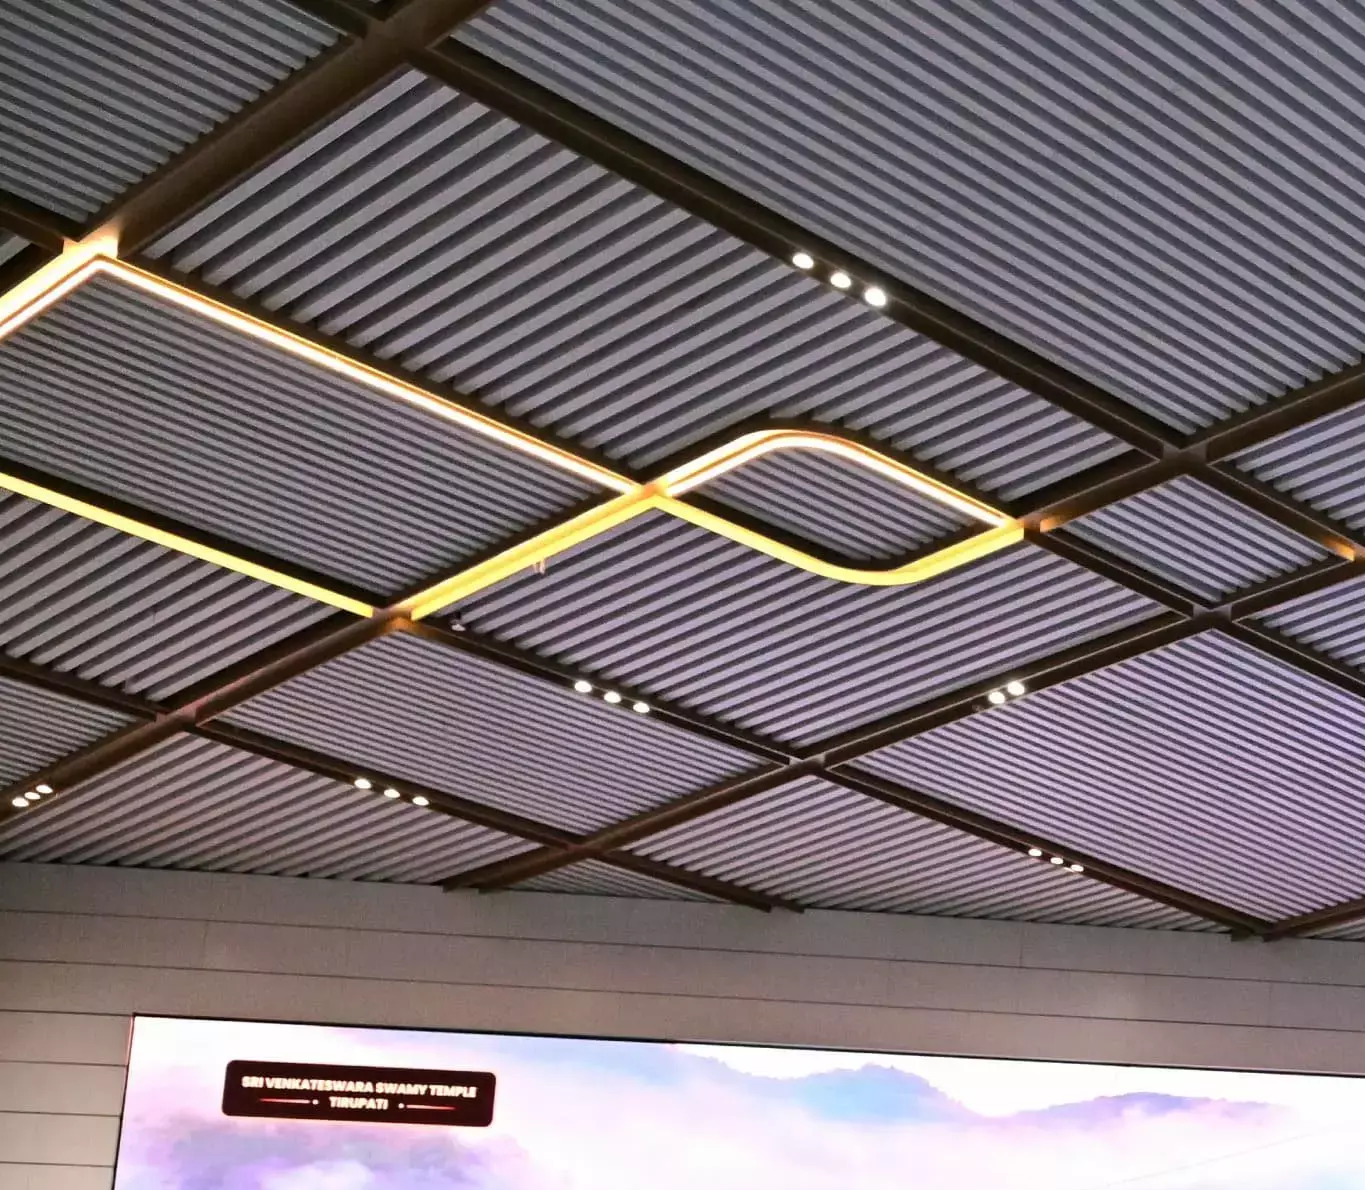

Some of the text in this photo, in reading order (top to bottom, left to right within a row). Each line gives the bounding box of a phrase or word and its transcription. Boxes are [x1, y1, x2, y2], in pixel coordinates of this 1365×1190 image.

[241, 1076, 478, 1098] SRI VENKATESWARA SWAMY TEMPLE
[329, 1096, 388, 1110] TIRUPATI
